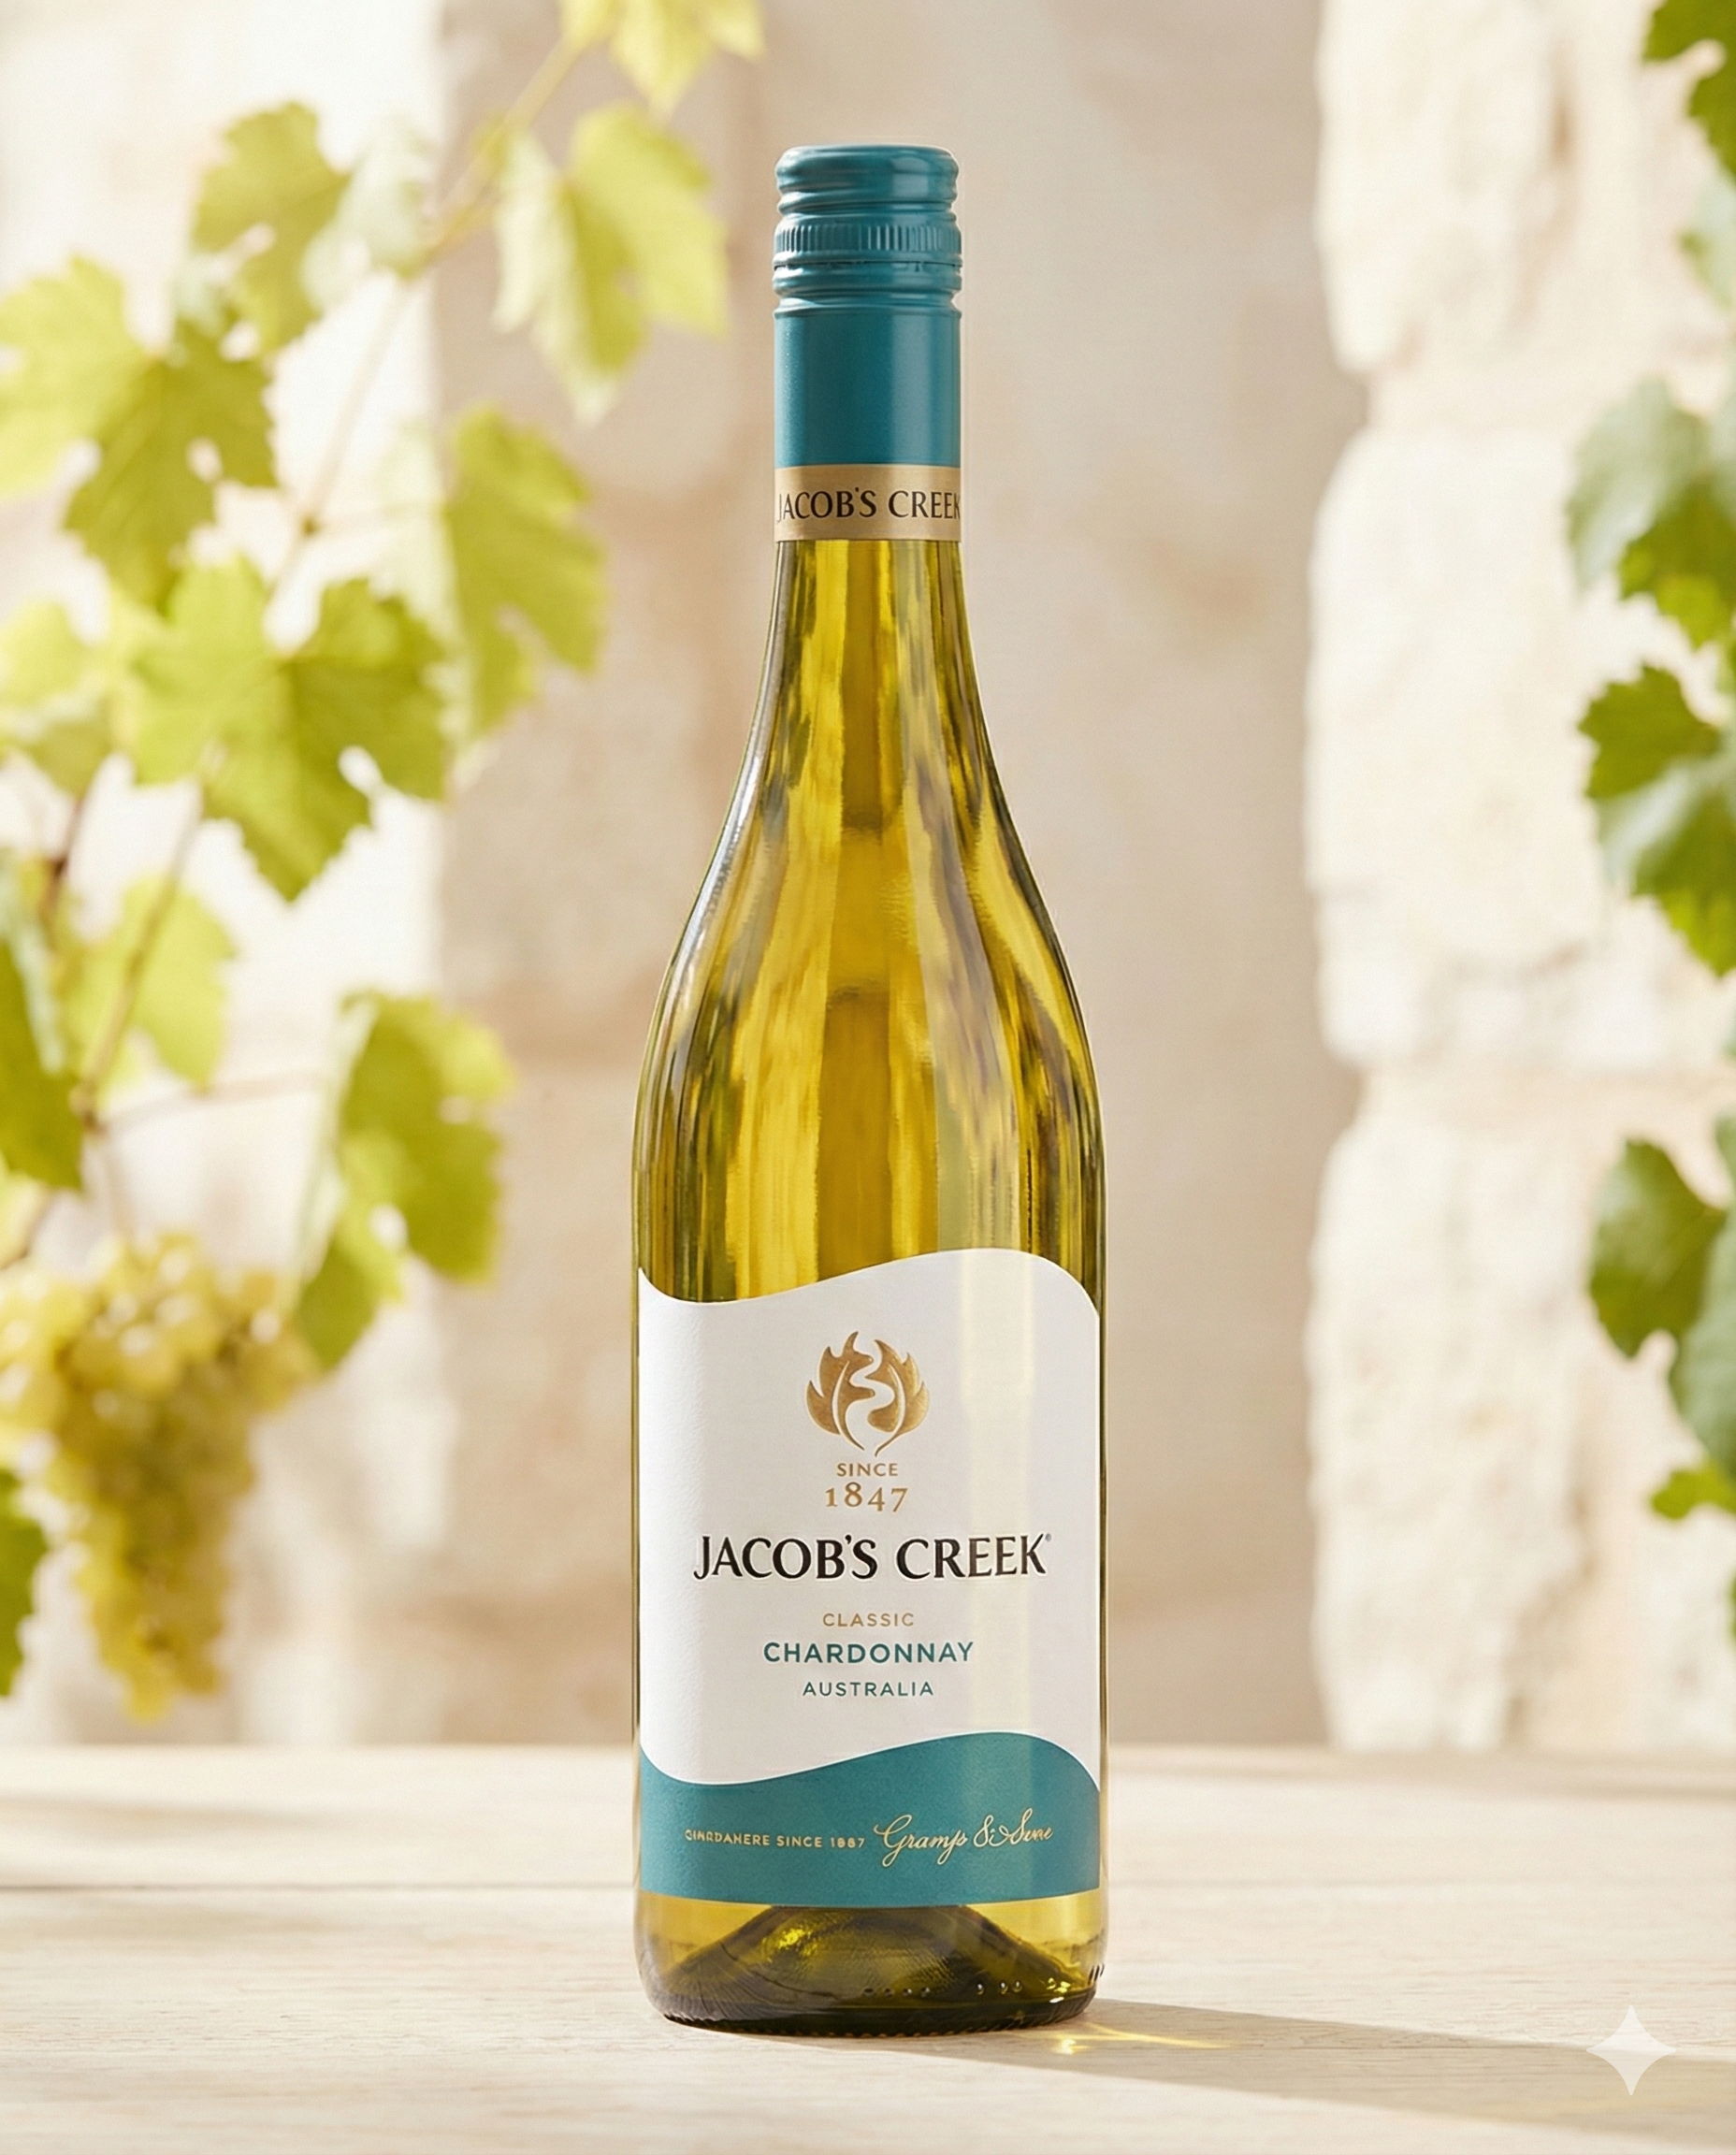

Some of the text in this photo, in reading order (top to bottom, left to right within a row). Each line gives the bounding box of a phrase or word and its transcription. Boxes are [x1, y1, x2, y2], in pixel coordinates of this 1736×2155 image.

[777, 486, 961, 522] JACOB'S CREEK
[836, 1463, 898, 1477] SINCE
[825, 1482, 908, 1513] 1847
[693, 1532, 1047, 1580] JACOB'S CREEK
[822, 1613, 914, 1627] CLASSIC
[763, 1642, 974, 1664] CHARDONNAY
[803, 1681, 933, 1697] AUSTRALIA
[776, 1835, 823, 1848] SINCE
